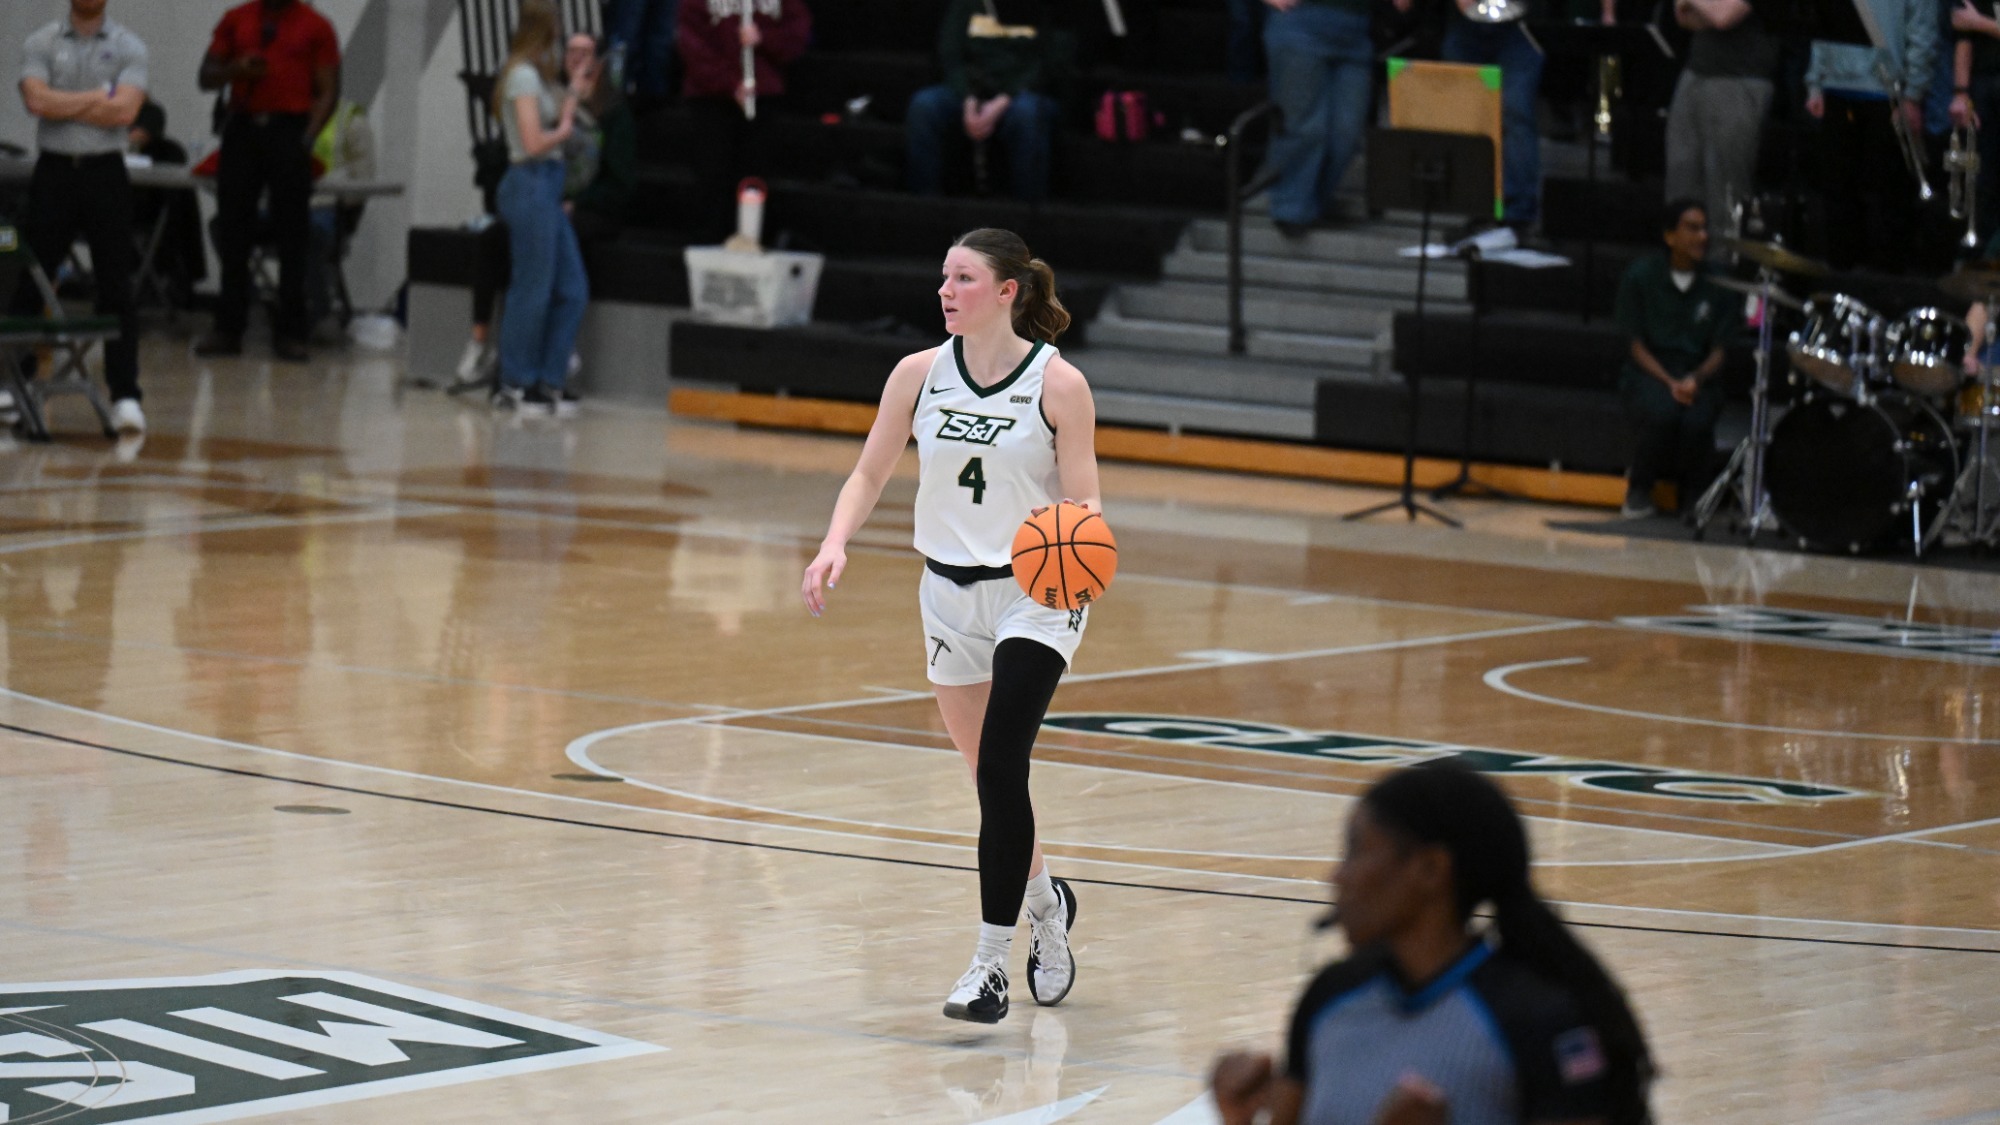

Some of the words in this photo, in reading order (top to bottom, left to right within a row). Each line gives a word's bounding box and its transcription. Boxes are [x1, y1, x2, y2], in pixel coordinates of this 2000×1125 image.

[935, 408, 1017, 445] S&T
[957, 456, 987, 504] 4
[1042, 712, 1866, 805] GLVC
[0, 990, 527, 1125] MIS
